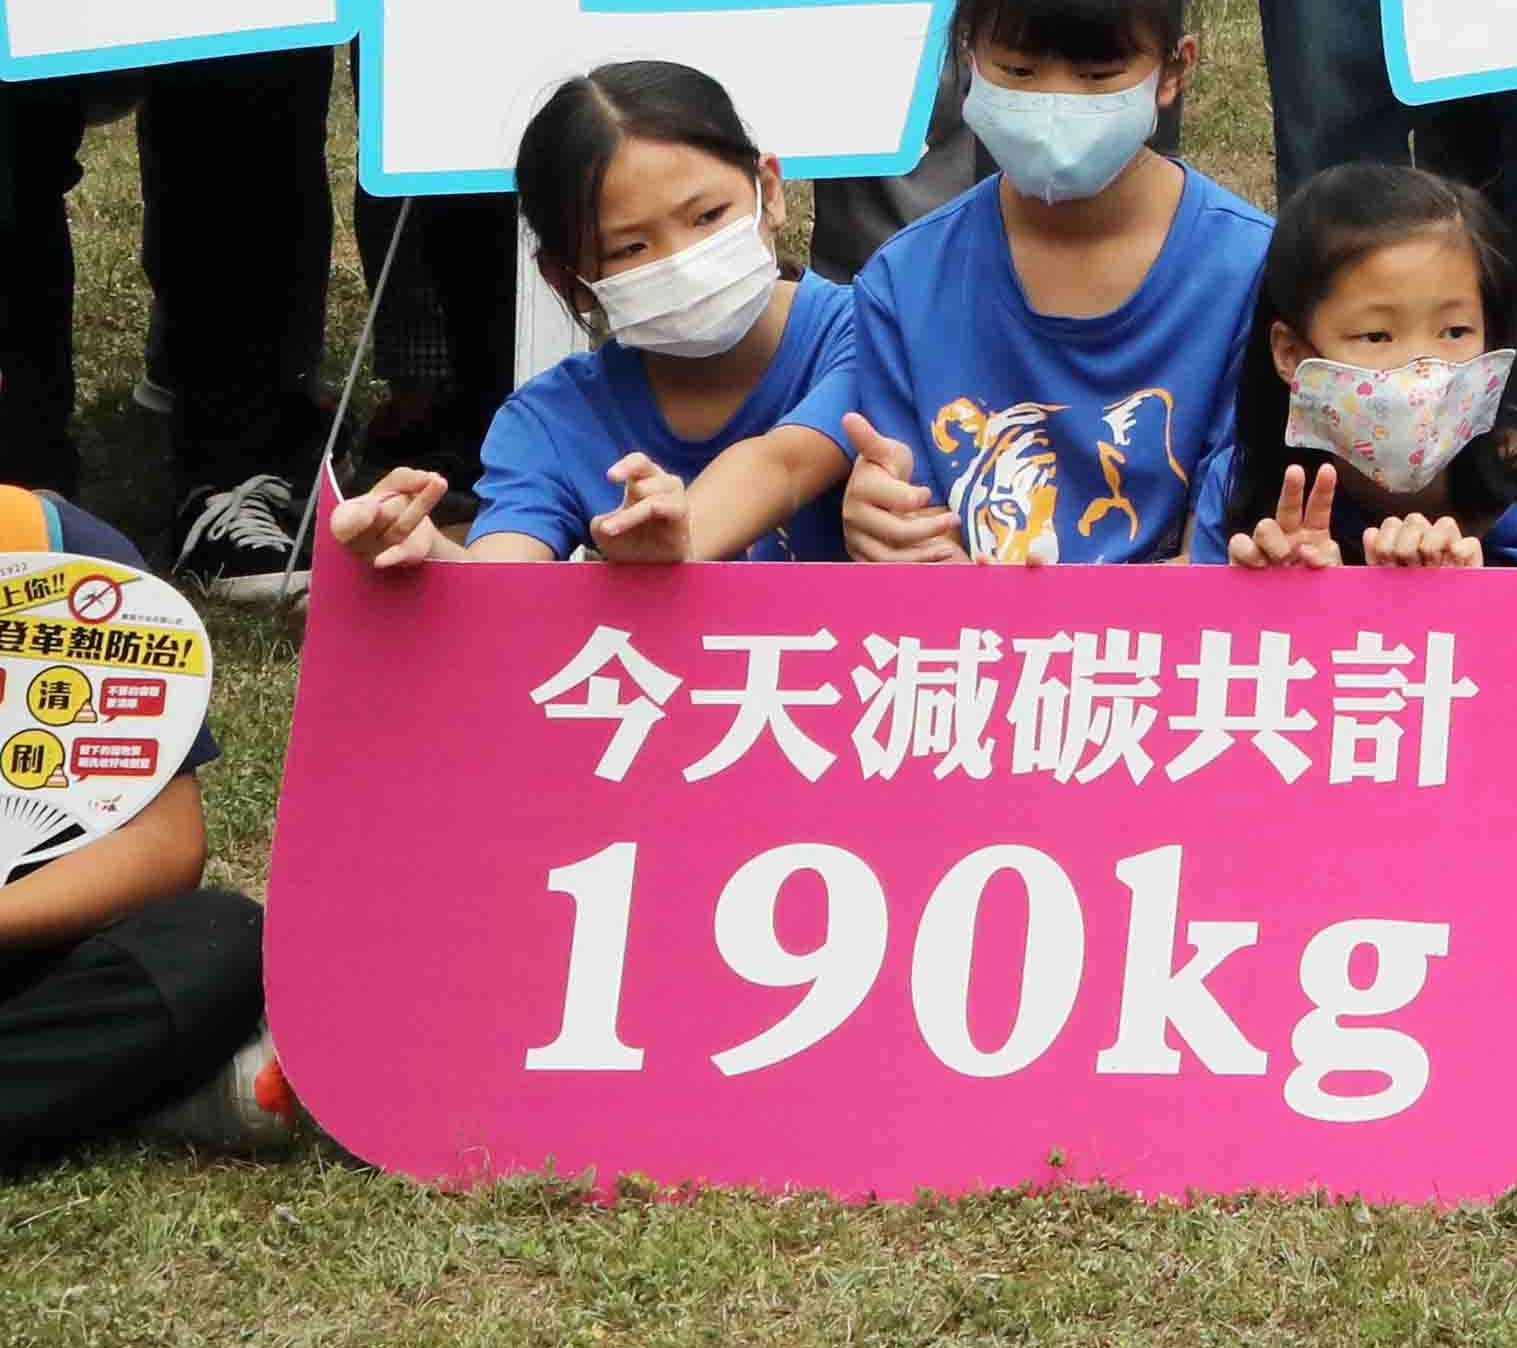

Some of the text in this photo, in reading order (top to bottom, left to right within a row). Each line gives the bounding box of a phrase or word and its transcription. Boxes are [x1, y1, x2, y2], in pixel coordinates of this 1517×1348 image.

[37, 680, 71, 710] 清
[529, 625, 1479, 787] 今天減碳共計
[11, 743, 45, 774] 刷
[524, 840, 1452, 1124] 190kg
